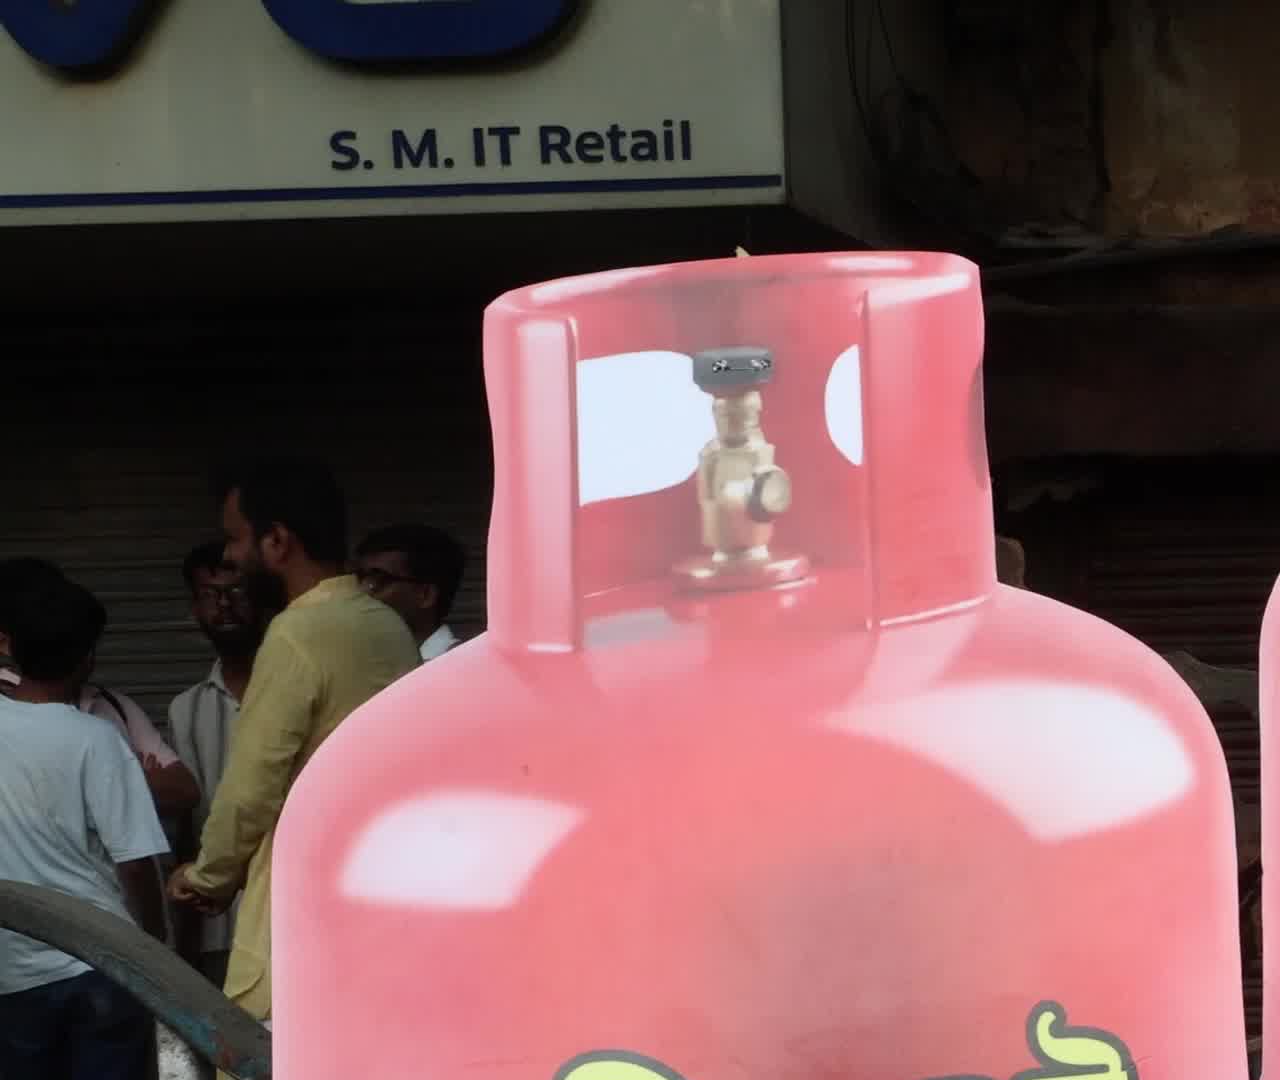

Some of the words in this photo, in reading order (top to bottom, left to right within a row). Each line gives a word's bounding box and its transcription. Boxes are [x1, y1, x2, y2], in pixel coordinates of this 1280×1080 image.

[329, 130, 374, 171] S.
[391, 128, 455, 169] M.
[472, 126, 521, 168] IT
[539, 119, 693, 165] Retail
